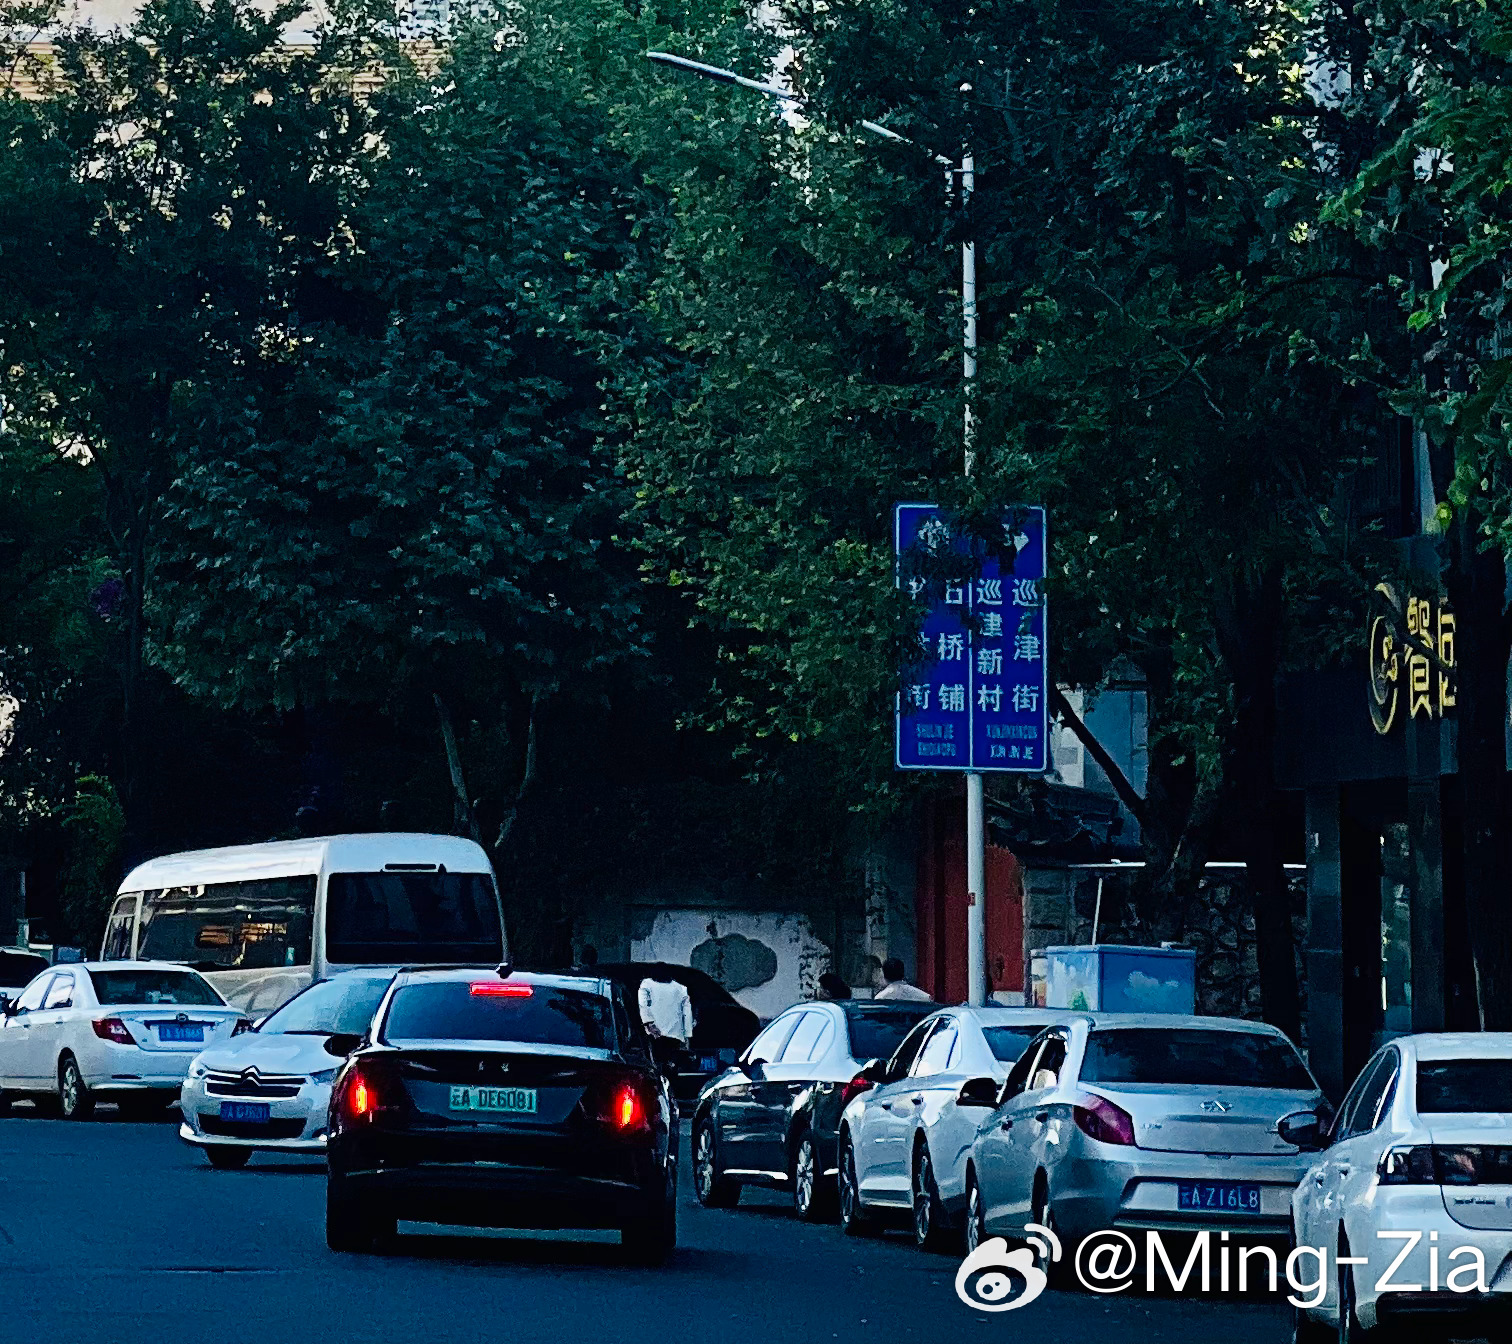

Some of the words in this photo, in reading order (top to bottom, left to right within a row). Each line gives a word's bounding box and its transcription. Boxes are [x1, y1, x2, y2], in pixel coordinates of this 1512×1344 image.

[976, 578, 1003, 712] 巡津新村
[1012, 578, 1041, 712] 巡津街
